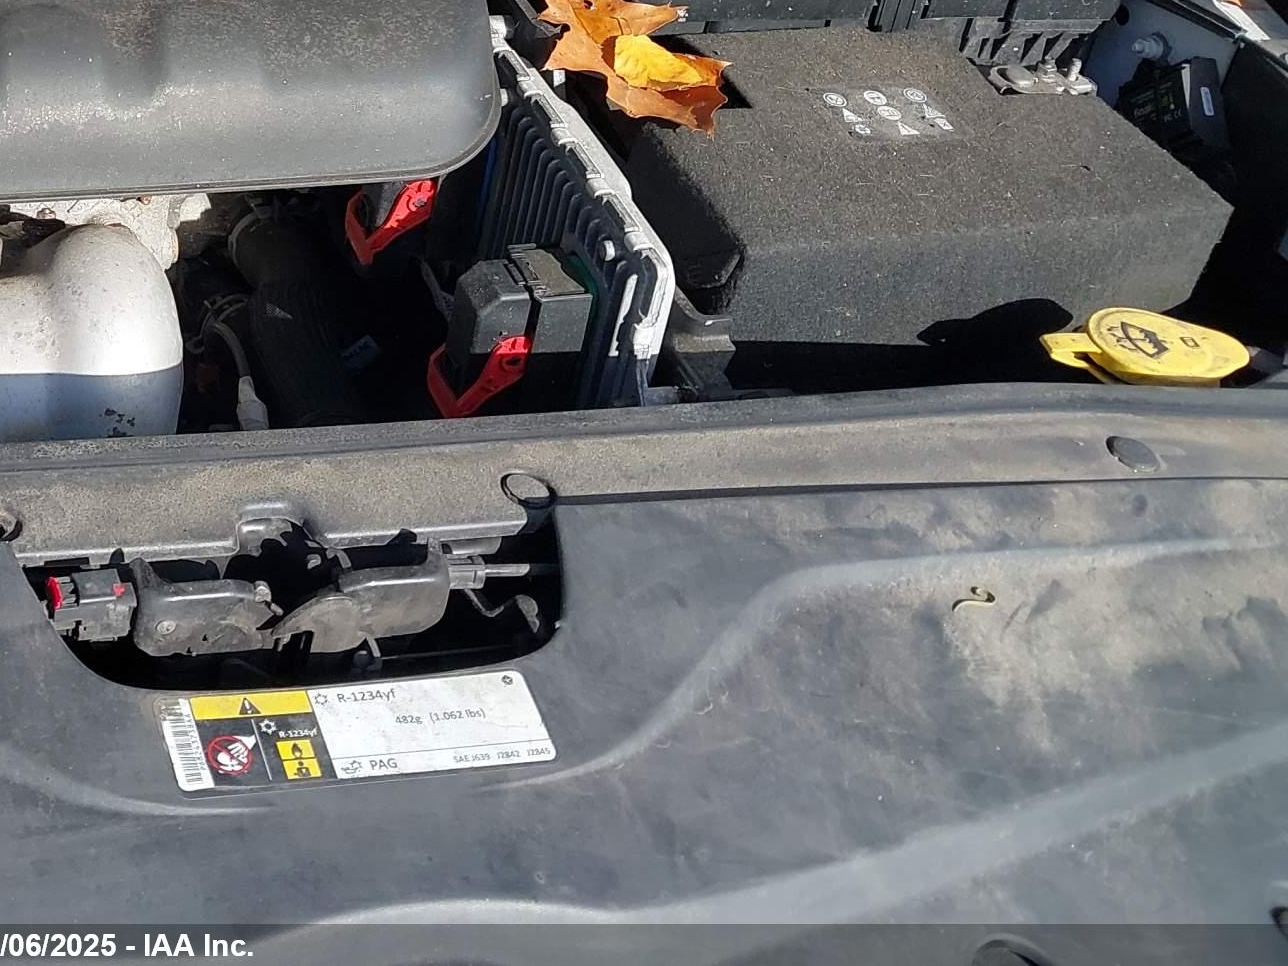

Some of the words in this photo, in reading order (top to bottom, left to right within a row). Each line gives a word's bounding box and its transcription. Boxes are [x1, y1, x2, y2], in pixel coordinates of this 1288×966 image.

[336, 688, 396, 703] R-1234yf
[395, 714, 423, 725] 482g
[429, 710, 464, 725] (1.062
[465, 708, 487, 719] lbs)
[369, 757, 398, 771] PAG
